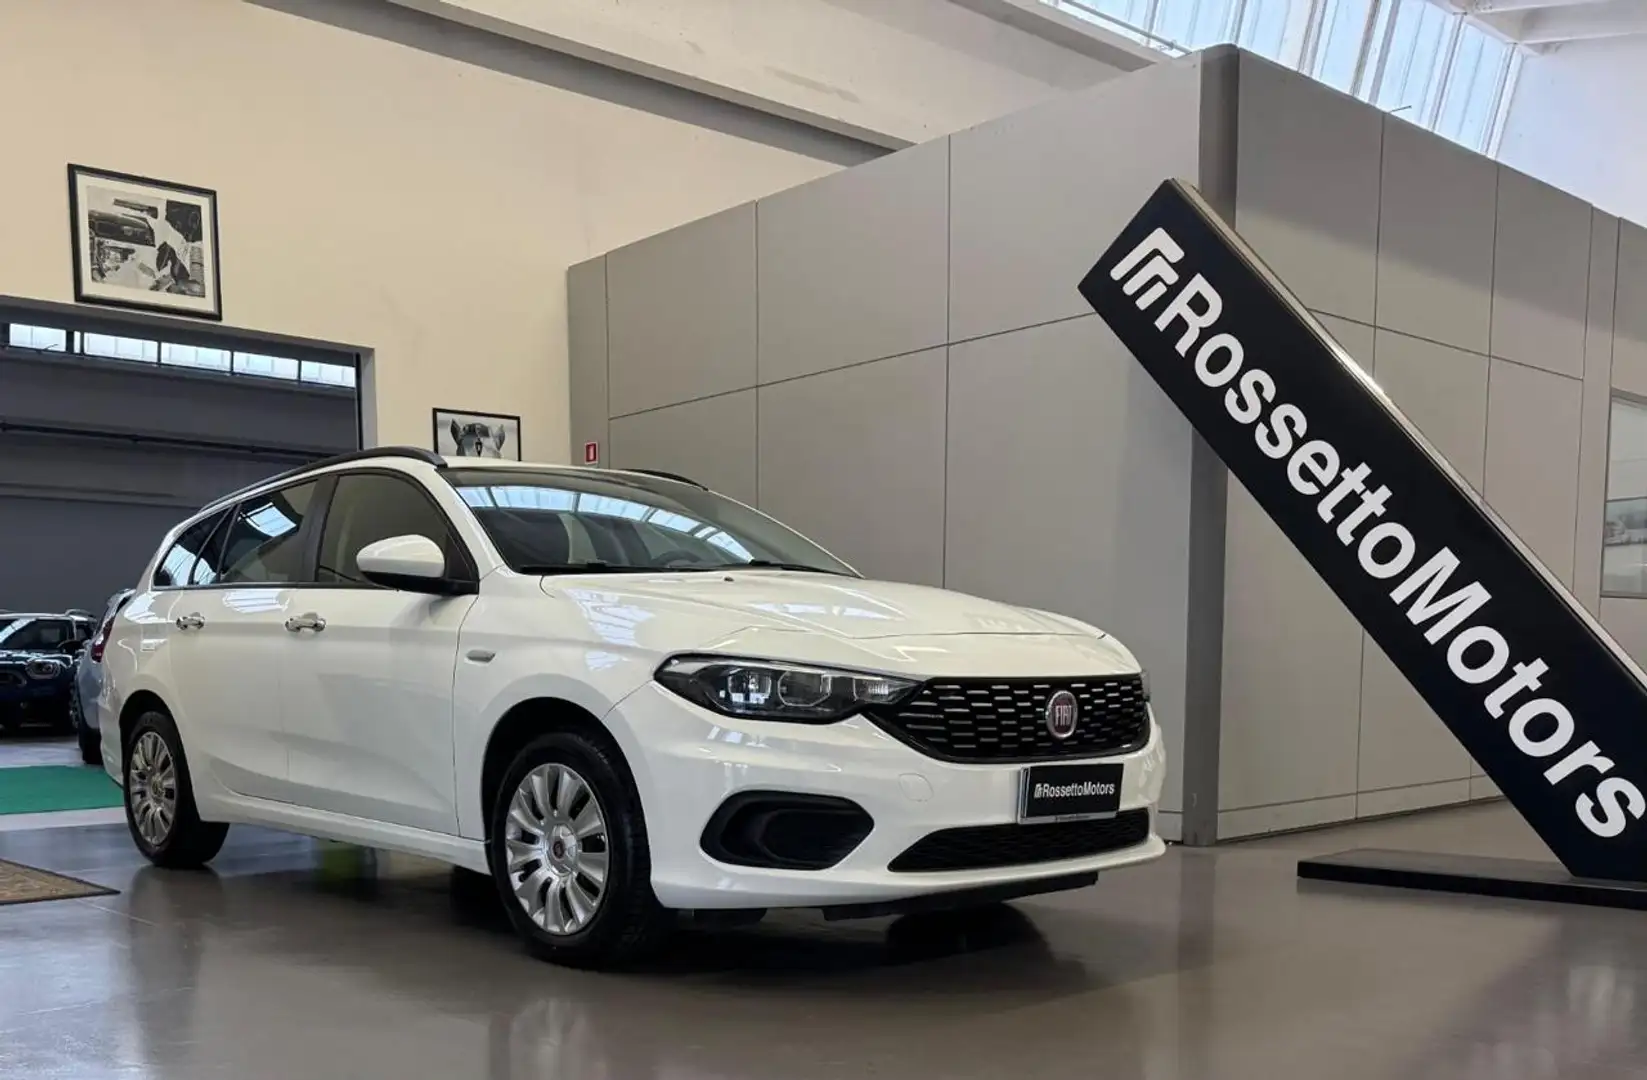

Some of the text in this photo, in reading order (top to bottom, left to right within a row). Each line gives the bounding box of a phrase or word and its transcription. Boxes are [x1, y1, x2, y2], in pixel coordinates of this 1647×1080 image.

[1154, 272, 1646, 838] RossettoMotors
[1055, 705, 1072, 726] FIAT
[1043, 781, 1115, 798] RossettoMotors
